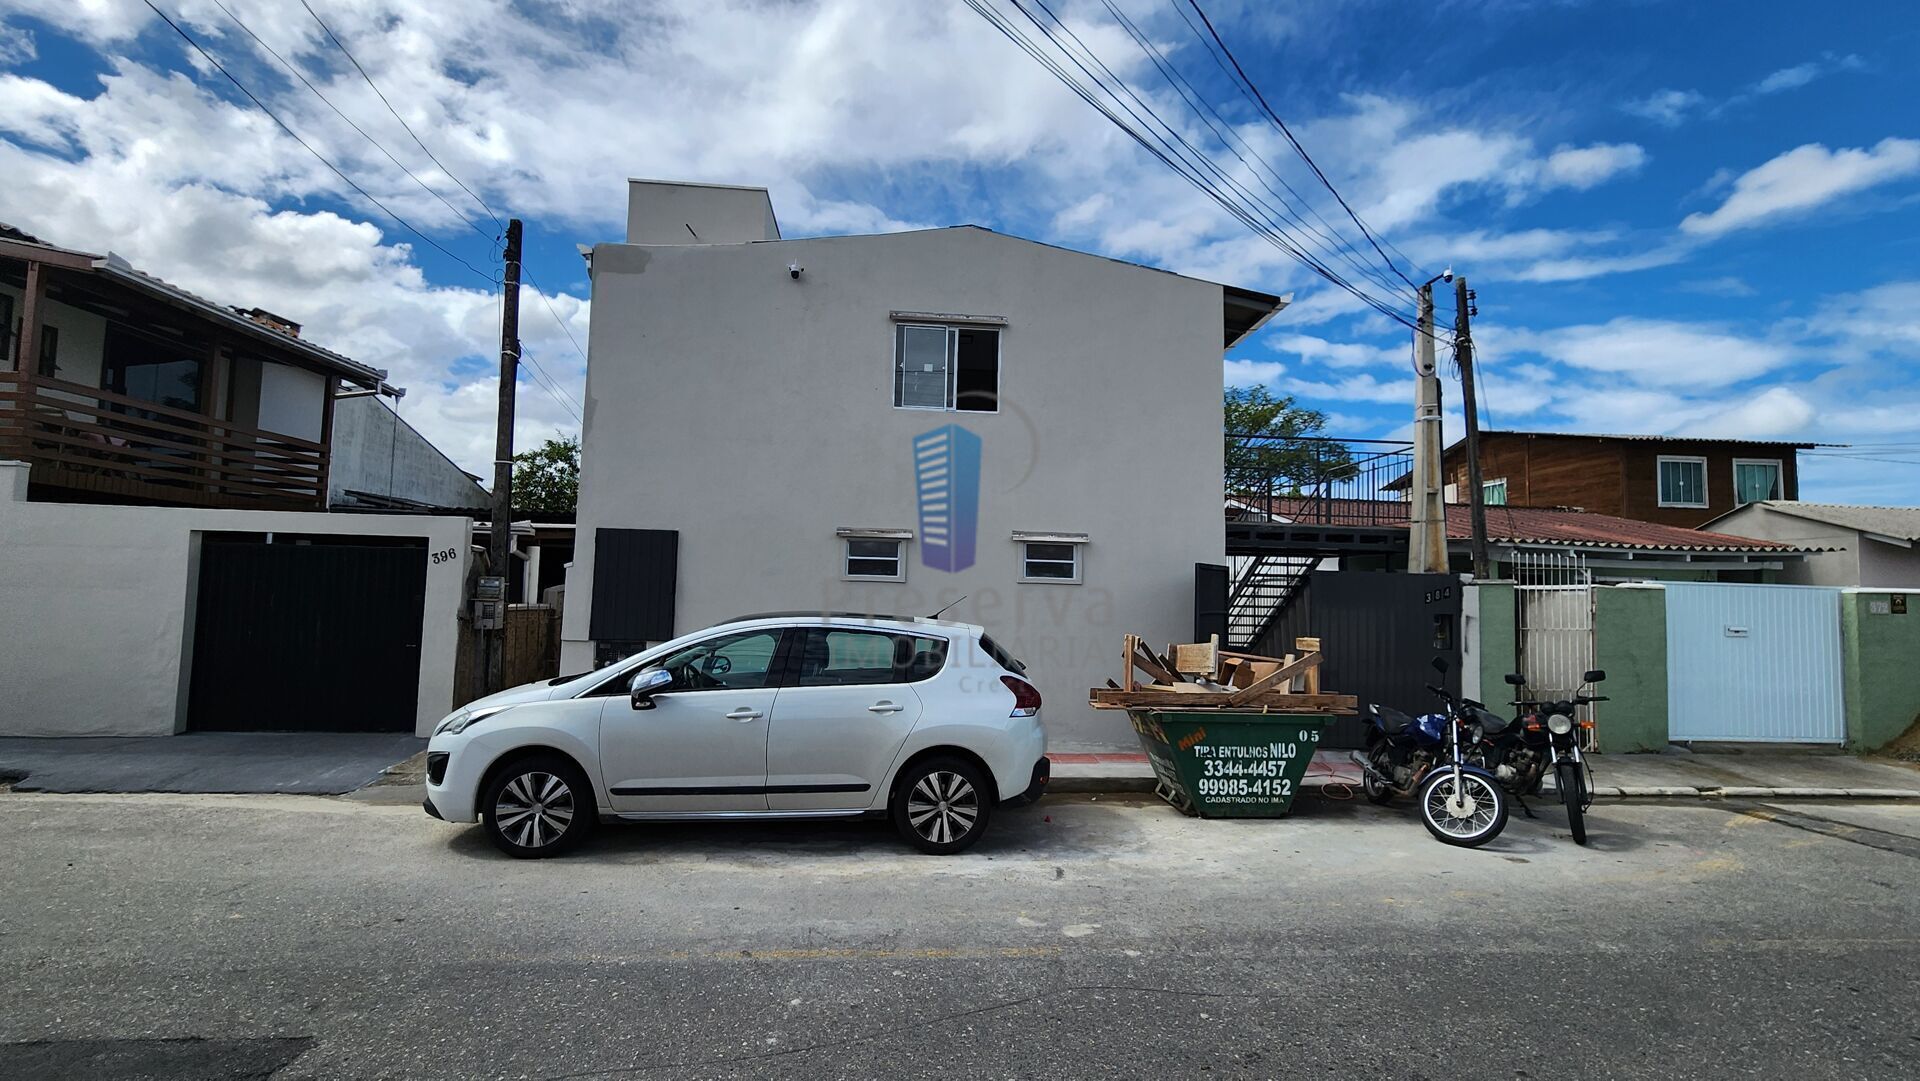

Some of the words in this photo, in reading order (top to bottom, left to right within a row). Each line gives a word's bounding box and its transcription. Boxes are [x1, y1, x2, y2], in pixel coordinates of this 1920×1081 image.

[432, 548, 457, 564] 396
[1218, 746, 1269, 759] ENTULHOS
[1269, 742, 1297, 759] NILO
[1205, 796, 1257, 804] CADASTRADO
[1258, 796, 1270, 804] NO
